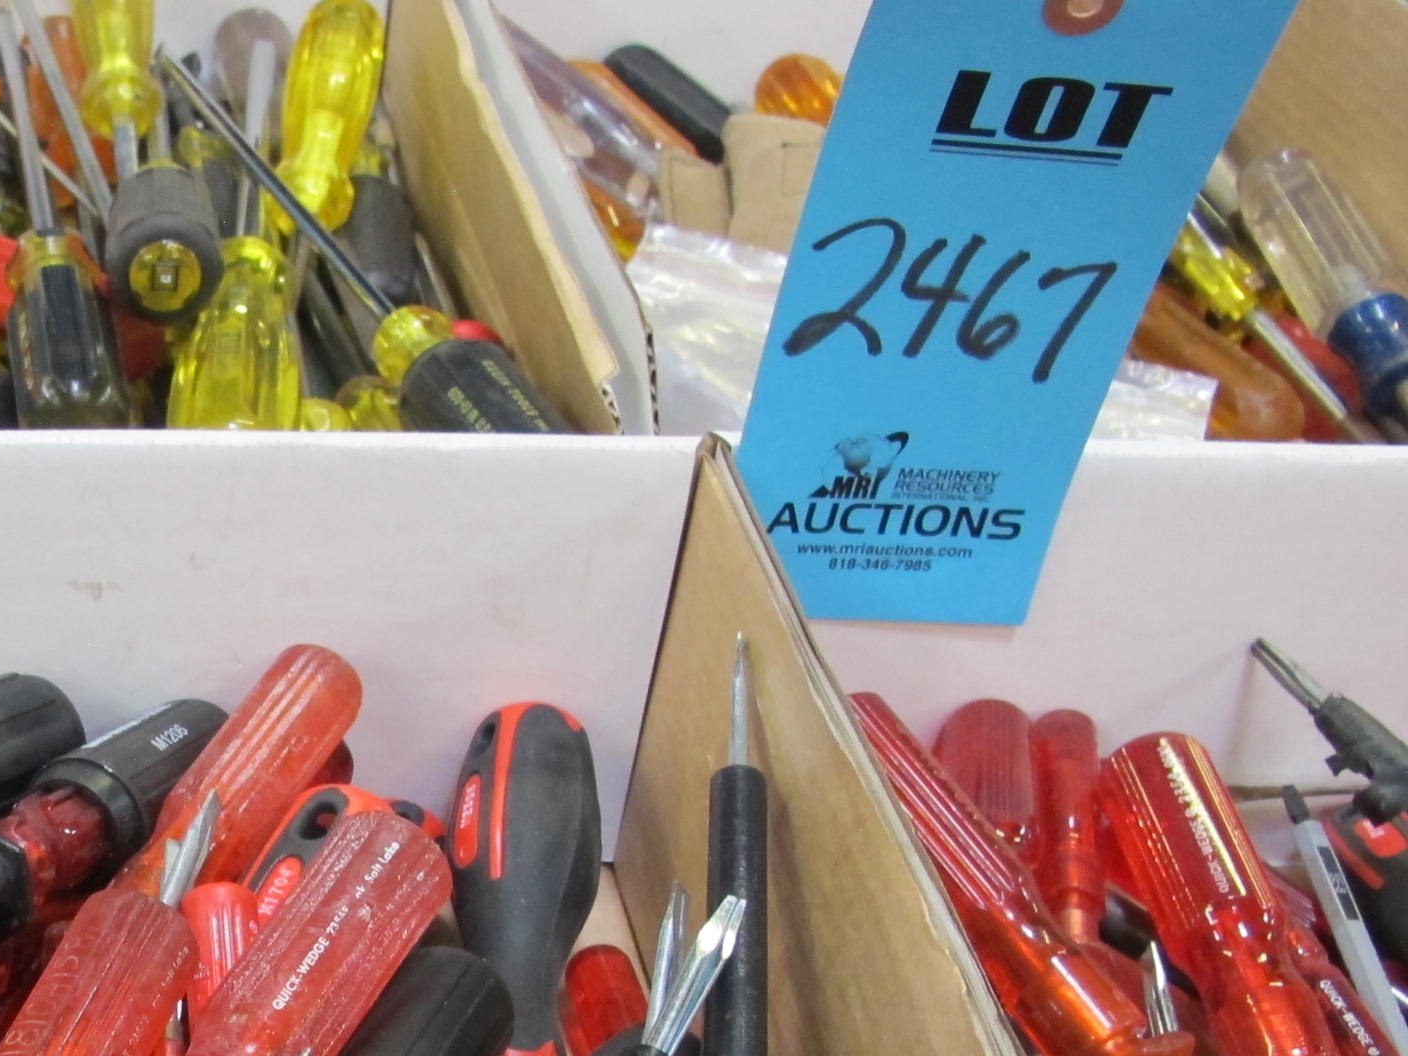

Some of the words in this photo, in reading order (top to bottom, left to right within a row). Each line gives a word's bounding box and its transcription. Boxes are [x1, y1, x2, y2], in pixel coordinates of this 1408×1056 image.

[936, 70, 1174, 149] LOT
[782, 217, 1118, 384] 2467
[829, 471, 888, 500] MRI
[894, 480, 995, 495] RESOURCES
[897, 467, 1001, 483] MACHINERY
[890, 492, 967, 502] INTERNATIONAL
[766, 502, 1026, 541] AUCTIONS
[797, 542, 973, 559] www.mriauctions.com
[828, 557, 932, 572] 818-346-7985
[272, 936, 331, 1010] QUICK-WEDGE
[377, 841, 401, 865] Lake
[1319, 979, 1374, 1047] QUICK-WEDGE
